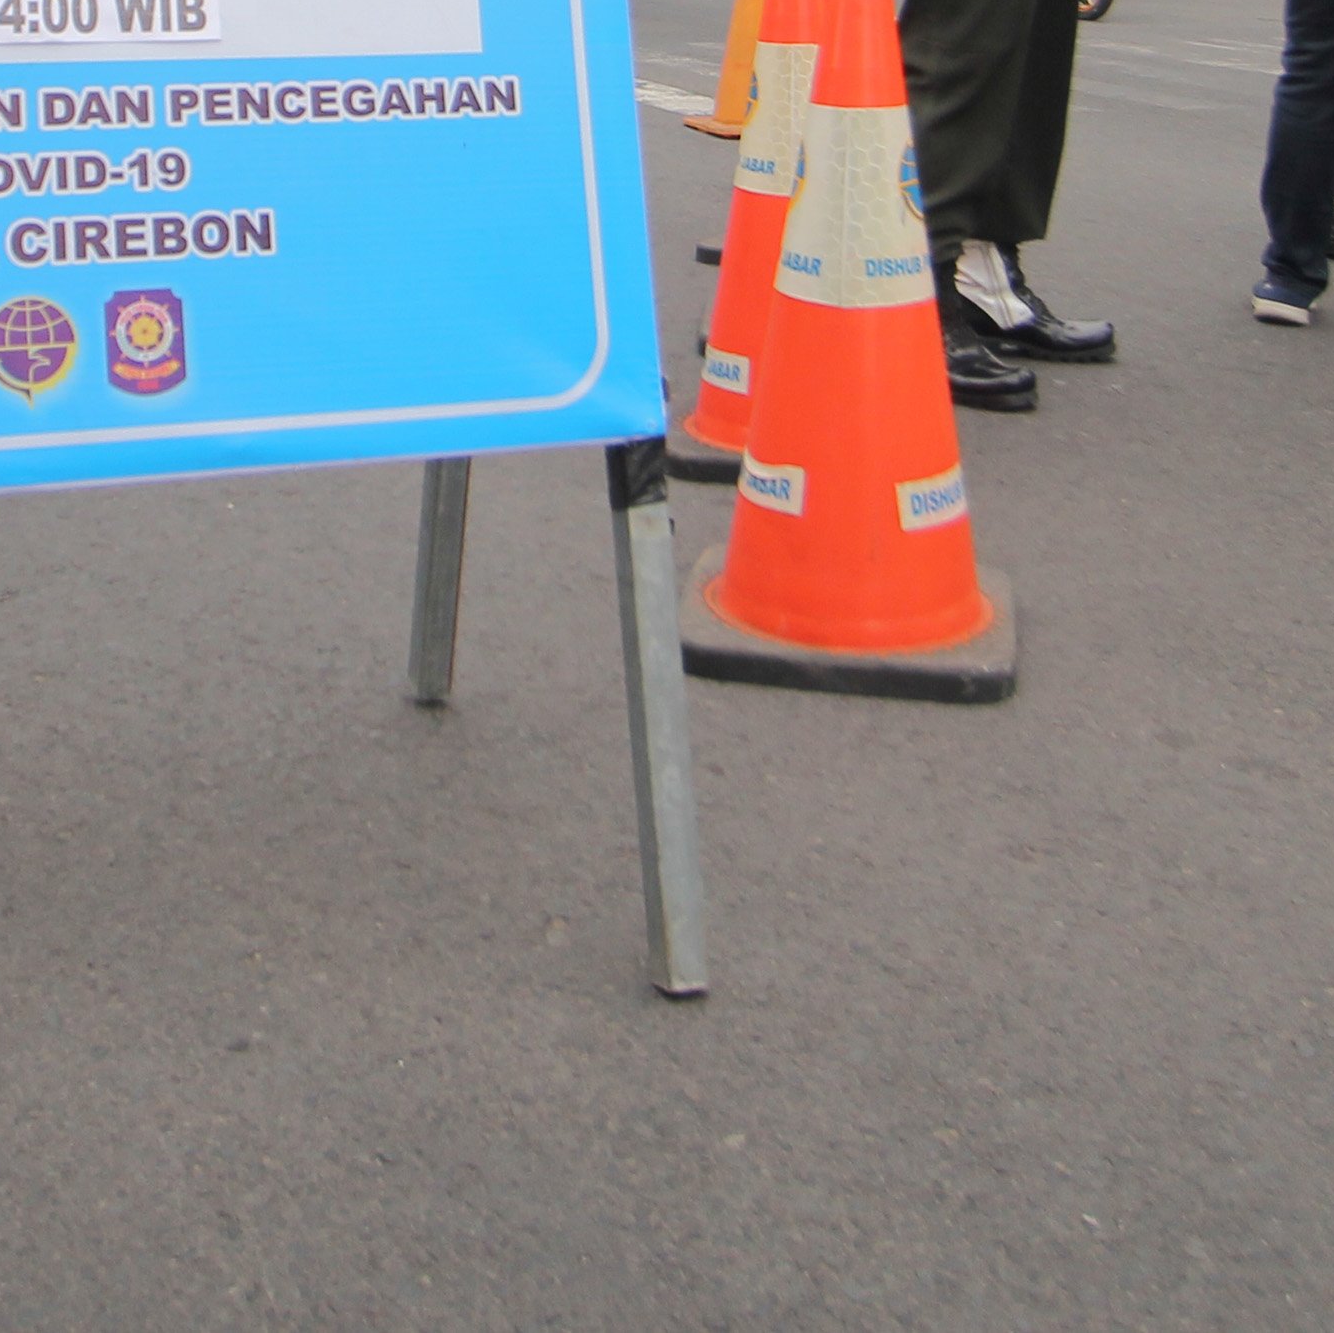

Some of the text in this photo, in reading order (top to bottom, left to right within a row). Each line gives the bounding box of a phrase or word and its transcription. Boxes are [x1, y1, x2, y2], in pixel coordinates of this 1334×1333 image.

[42, 88, 151, 128] DAN
[169, 78, 518, 123] PENCEGAHAN
[8, 211, 273, 263] CIREBON
[865, 256, 922, 278] DISHUB
